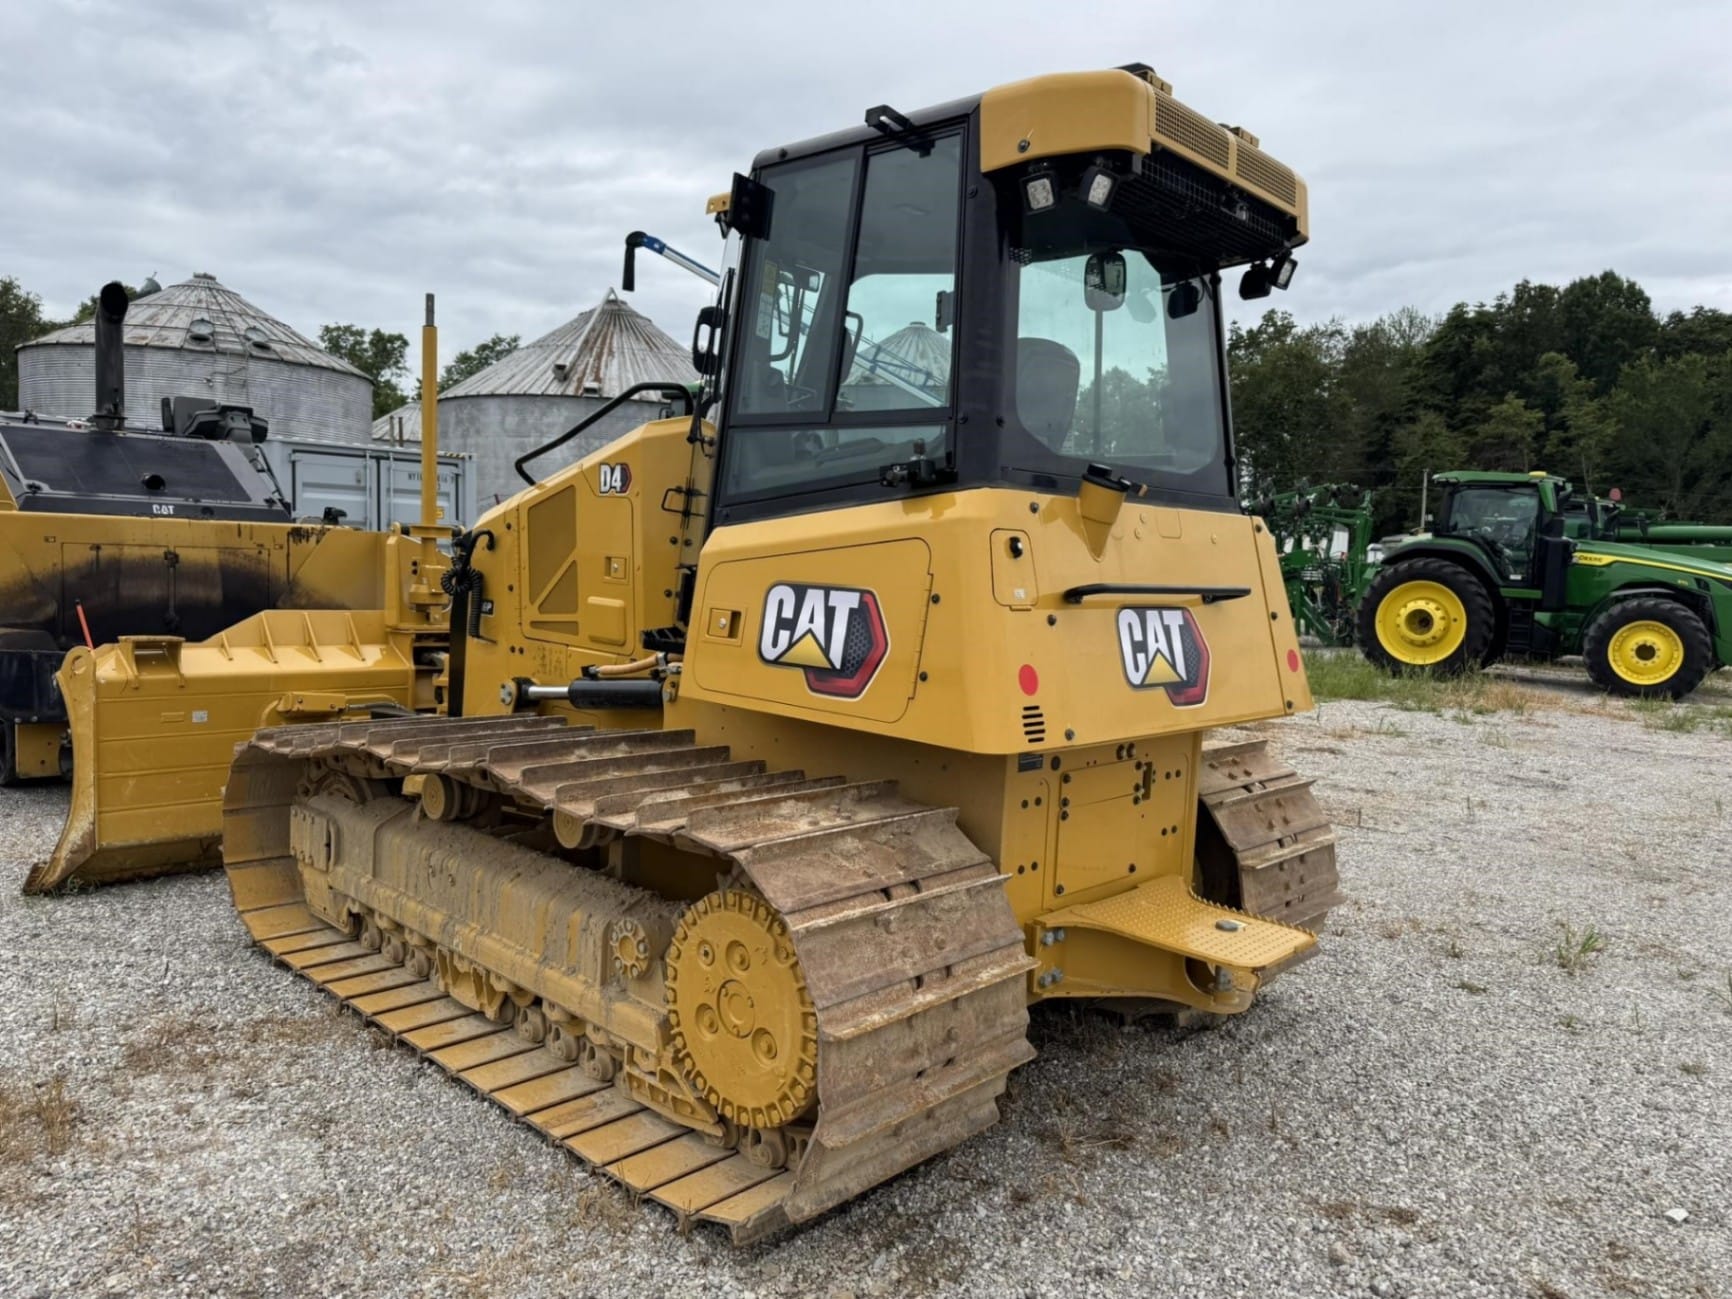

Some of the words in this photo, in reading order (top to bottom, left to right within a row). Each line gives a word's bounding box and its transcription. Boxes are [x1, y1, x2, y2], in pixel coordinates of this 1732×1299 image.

[600, 464, 622, 492] D4
[152, 504, 175, 515] CAT
[761, 585, 860, 670] CAT
[1118, 608, 1187, 685] CAT
